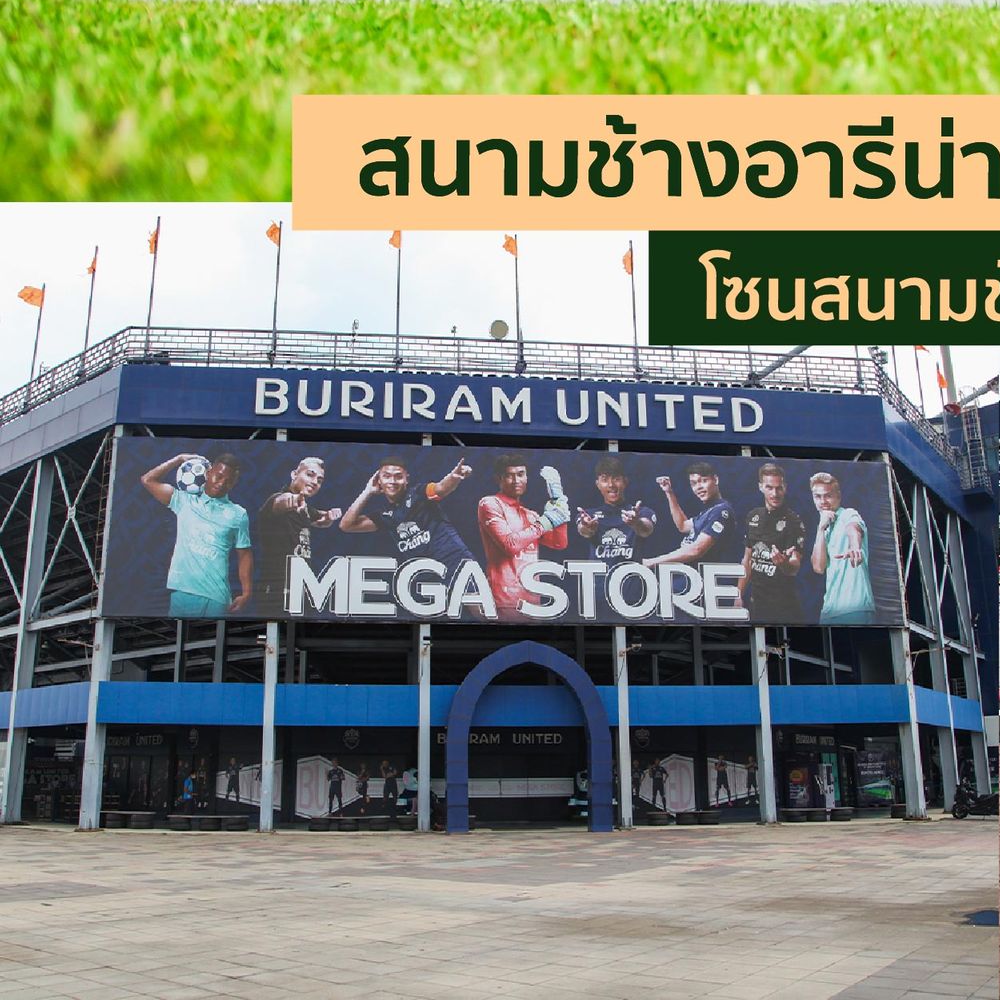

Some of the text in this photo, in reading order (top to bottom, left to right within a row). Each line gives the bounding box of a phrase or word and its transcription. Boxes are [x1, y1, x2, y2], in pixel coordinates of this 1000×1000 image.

[254, 376, 764, 434] BURIRAM UNITED
[397, 530, 432, 553] Chang
[595, 544, 634, 560] Chang
[285, 552, 750, 622] MEGA STORE
[436, 733, 563, 745] BRAM UNITED
